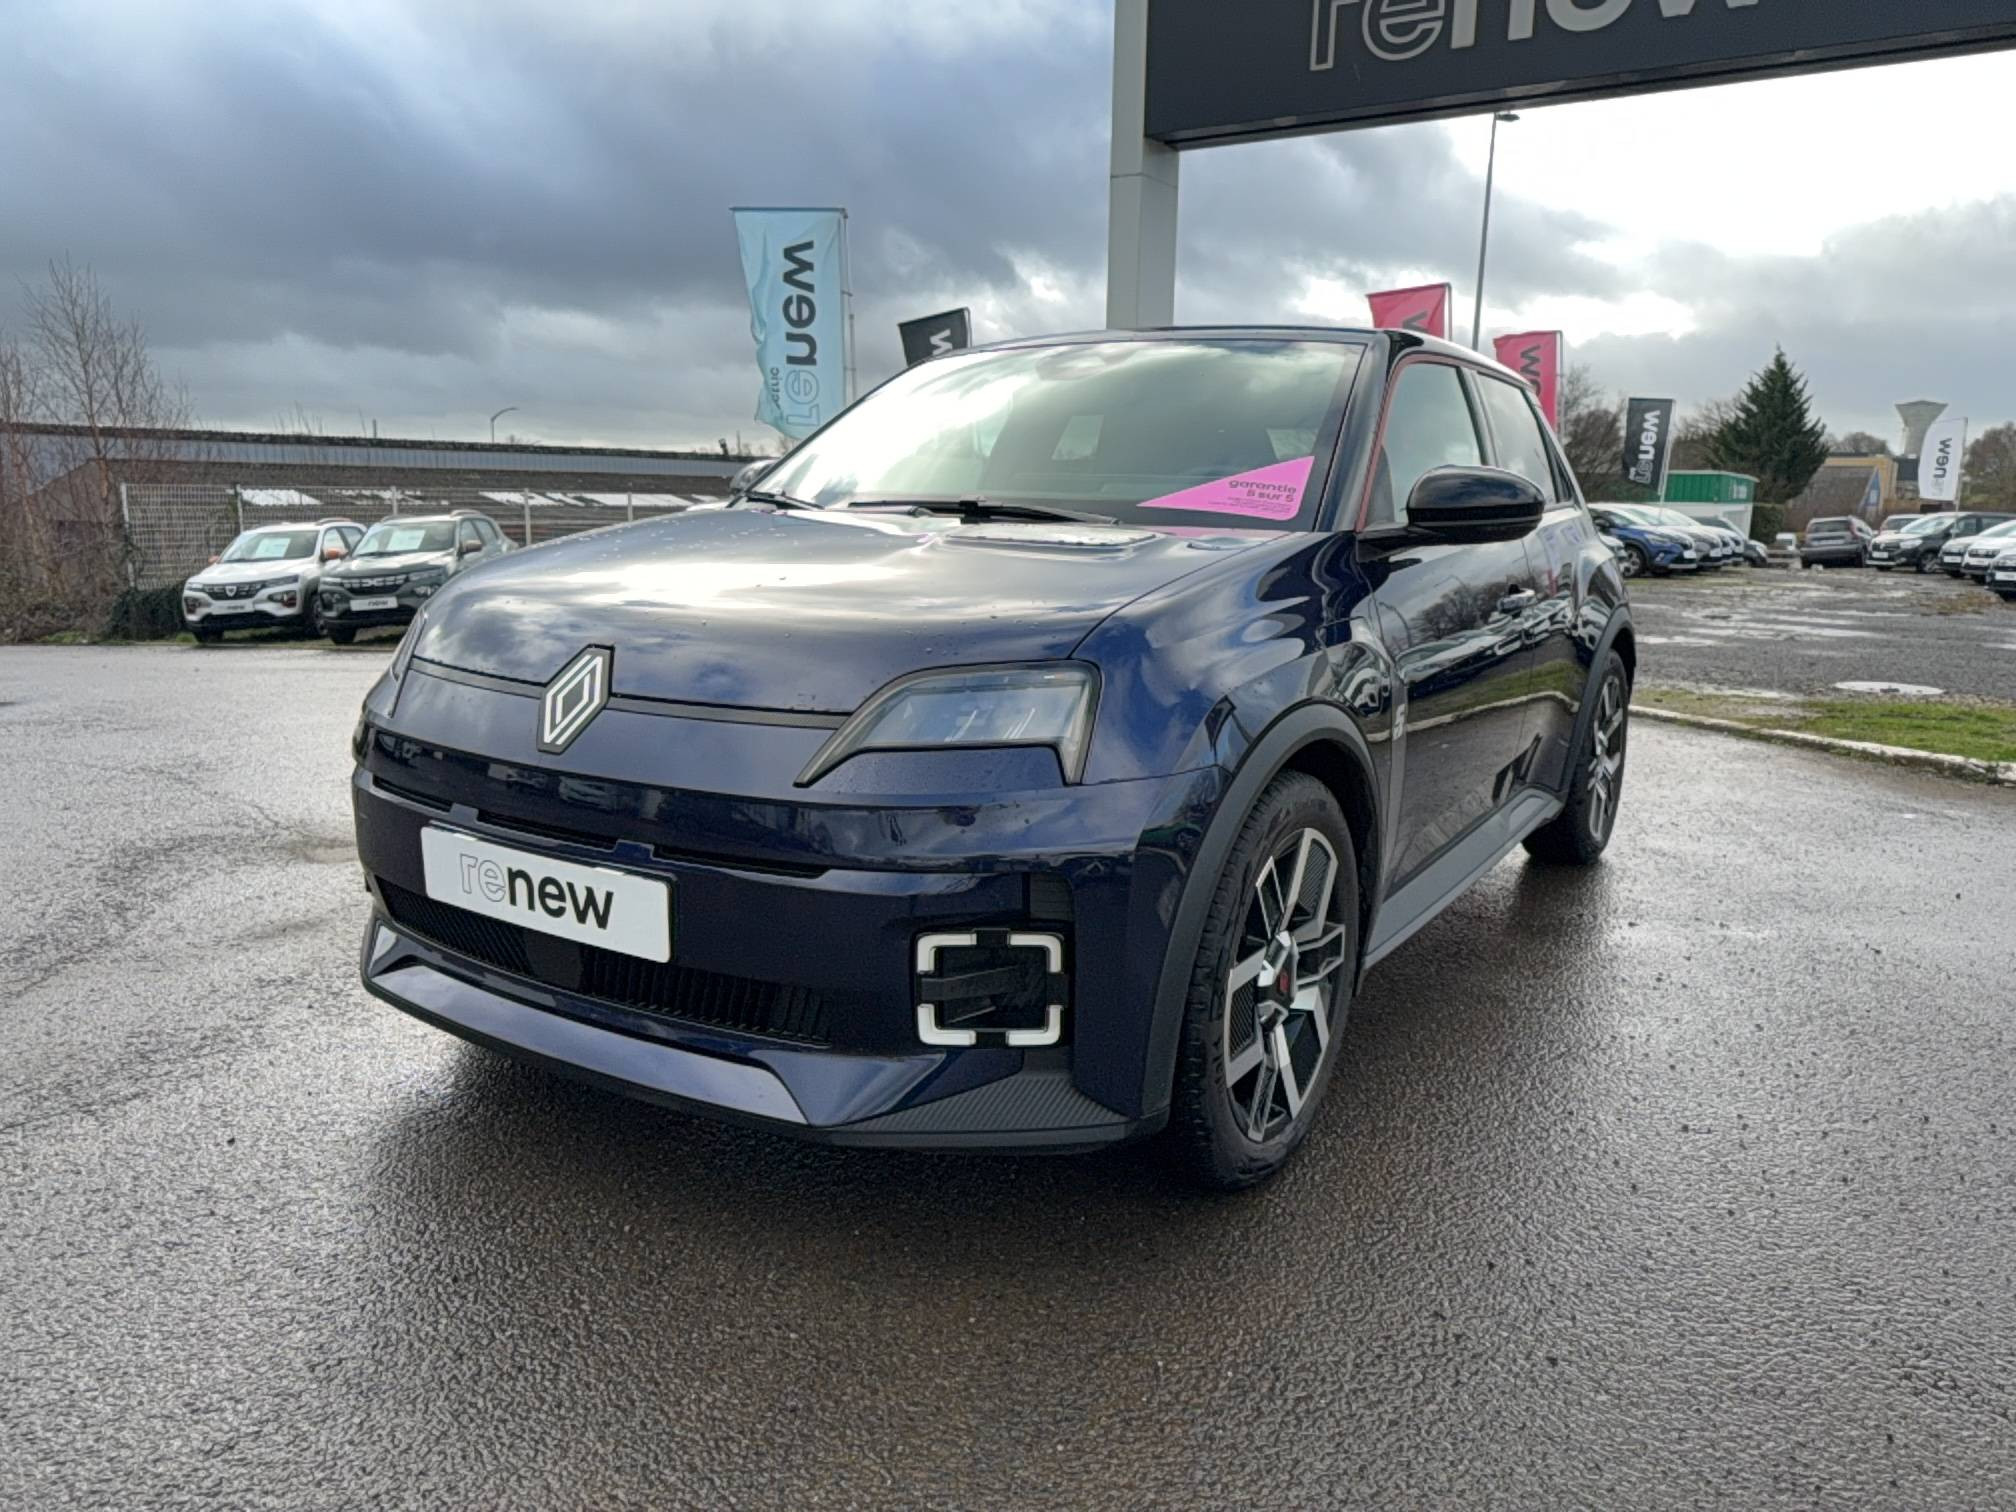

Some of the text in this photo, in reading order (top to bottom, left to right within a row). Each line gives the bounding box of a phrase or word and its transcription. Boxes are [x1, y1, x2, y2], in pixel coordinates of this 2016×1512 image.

[1229, 480, 1296, 494] garantie
[1258, 491, 1283, 500] sur
[1285, 494, 1295, 502] 5
[459, 853, 614, 930] renew
